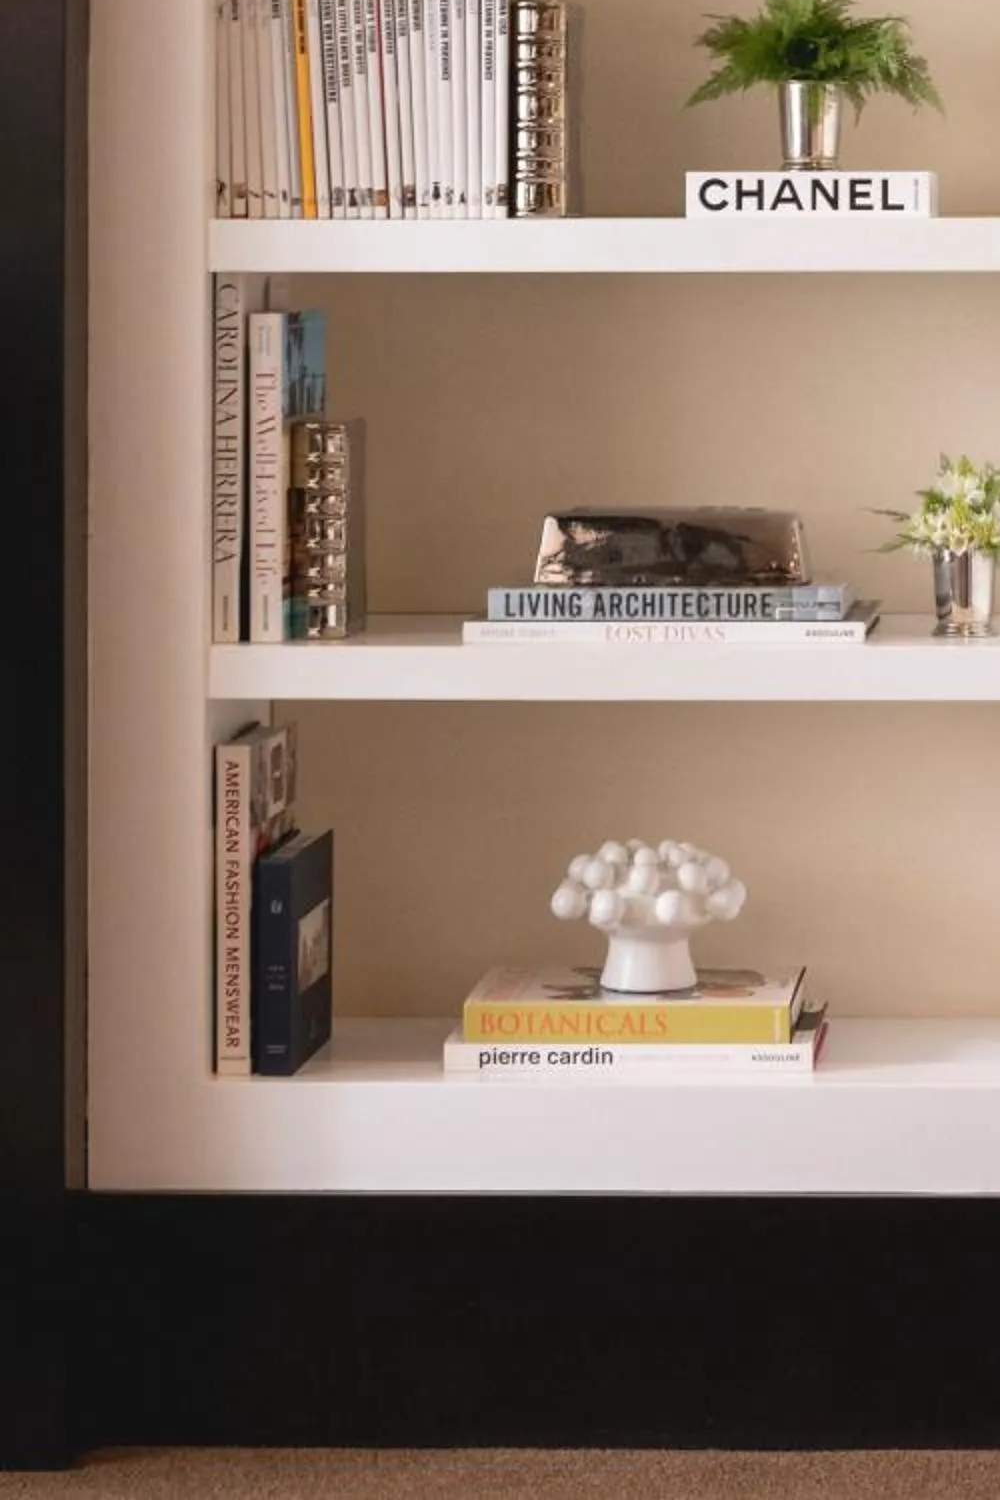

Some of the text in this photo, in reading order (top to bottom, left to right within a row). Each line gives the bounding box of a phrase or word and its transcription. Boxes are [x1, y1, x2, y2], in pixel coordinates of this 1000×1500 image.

[698, 177, 905, 212] CHANEL
[215, 282, 241, 427] CAROLINA
[254, 370, 278, 410] The
[215, 434, 241, 566] HERRERA
[503, 591, 773, 619] LIVING ARCHITECTURE
[604, 623, 659, 642] LOST
[663, 623, 726, 641] DIVAS
[224, 759, 241, 1049] AMERICAN FASHION MENSWEAR
[479, 1009, 668, 1037] BOTANICALS
[478, 1047, 541, 1069] pierre
[546, 1046, 614, 1066] cardin
